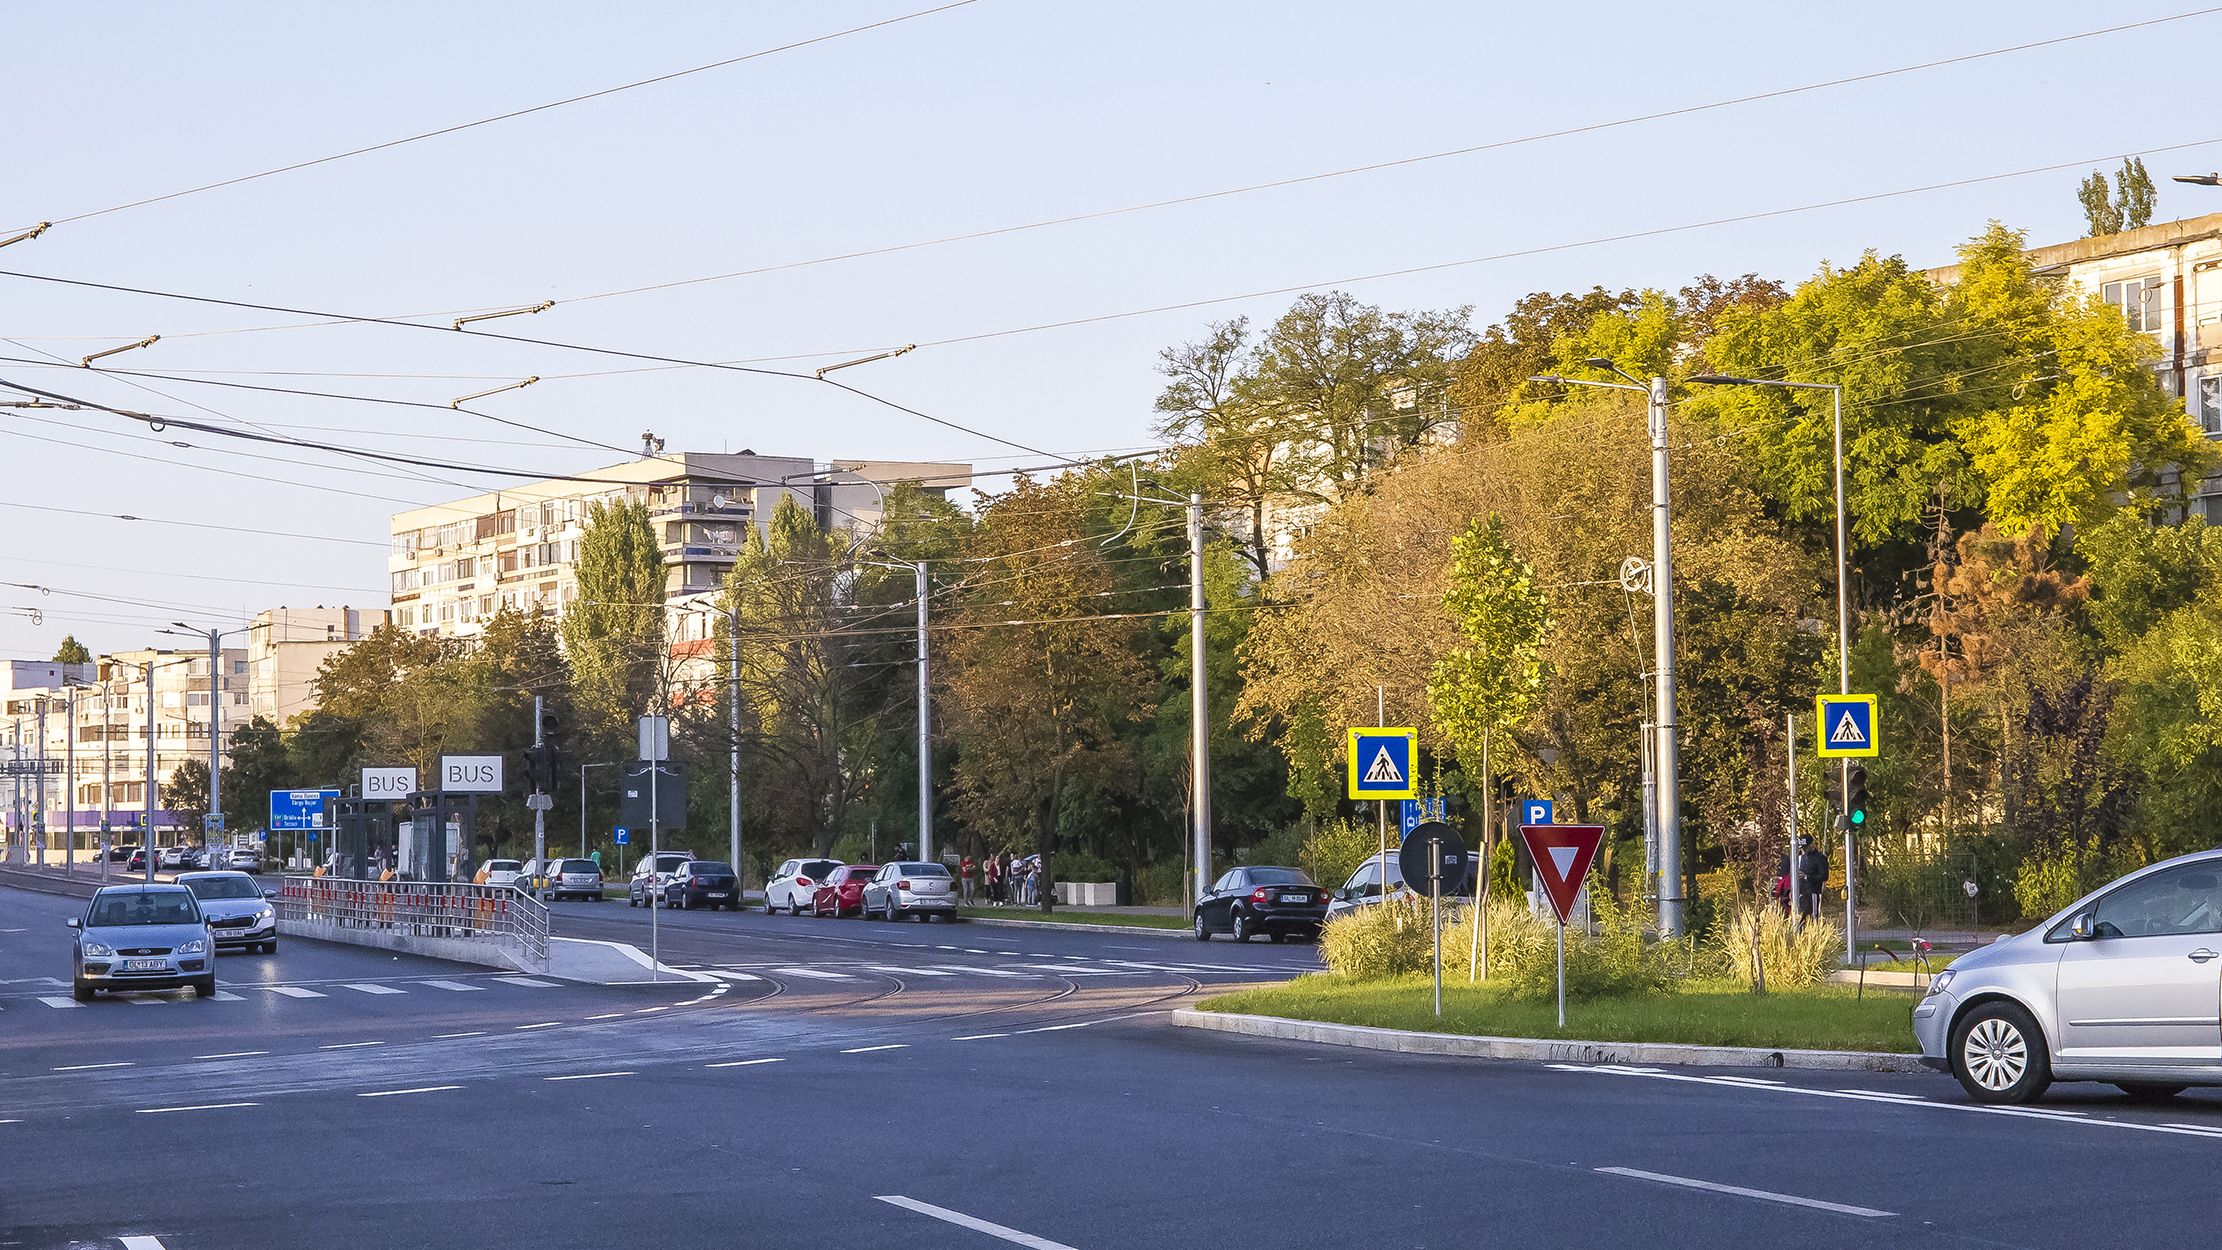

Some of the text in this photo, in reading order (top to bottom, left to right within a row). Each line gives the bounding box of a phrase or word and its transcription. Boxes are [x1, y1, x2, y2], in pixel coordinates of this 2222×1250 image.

[449, 765, 494, 783] BUS
[368, 776, 409, 792] BUS
[1530, 806, 1546, 825] P
[617, 829, 626, 840] P
